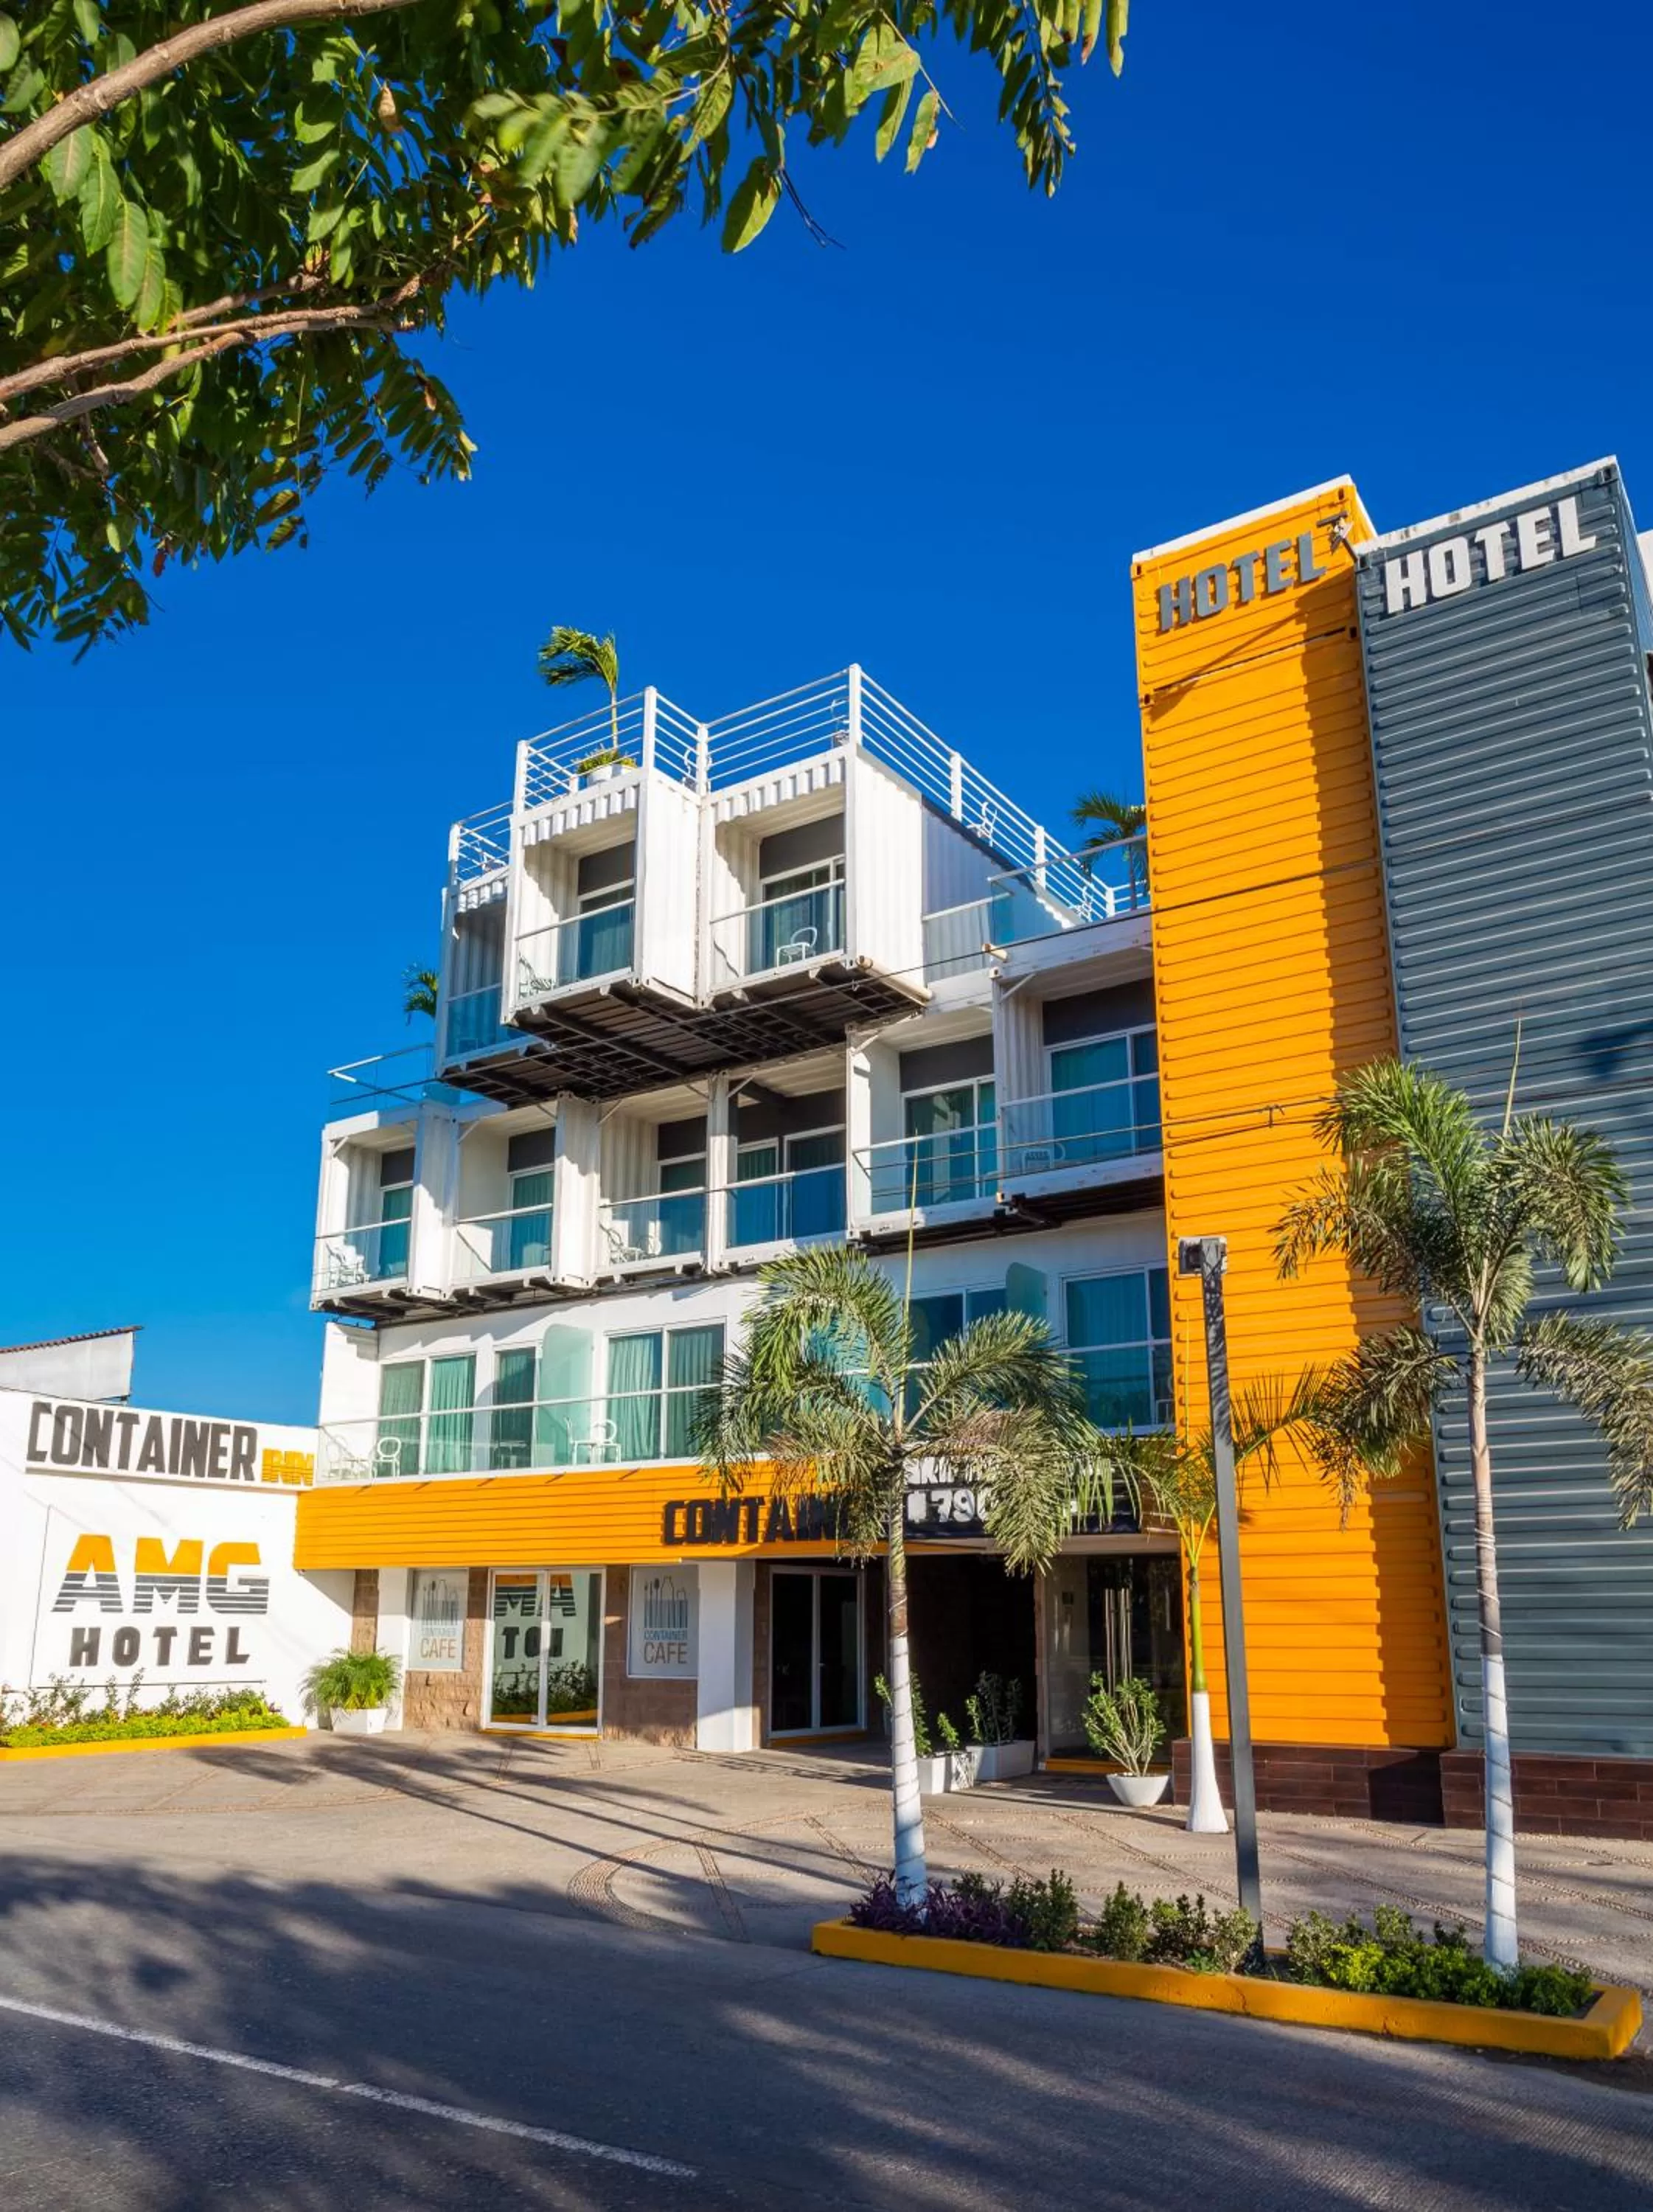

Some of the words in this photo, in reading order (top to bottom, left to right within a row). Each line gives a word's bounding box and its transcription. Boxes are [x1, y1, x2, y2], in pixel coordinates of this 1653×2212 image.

[1157, 530, 1327, 632] HOTEL
[1382, 495, 1596, 614] HOTEL
[27, 1400, 257, 1482] CONTAINER
[51, 1534, 270, 1615] AMG
[69, 1626, 251, 1668] HOTEL
[420, 1637, 457, 1658] CAFE
[644, 1641, 688, 1664] CAFE
